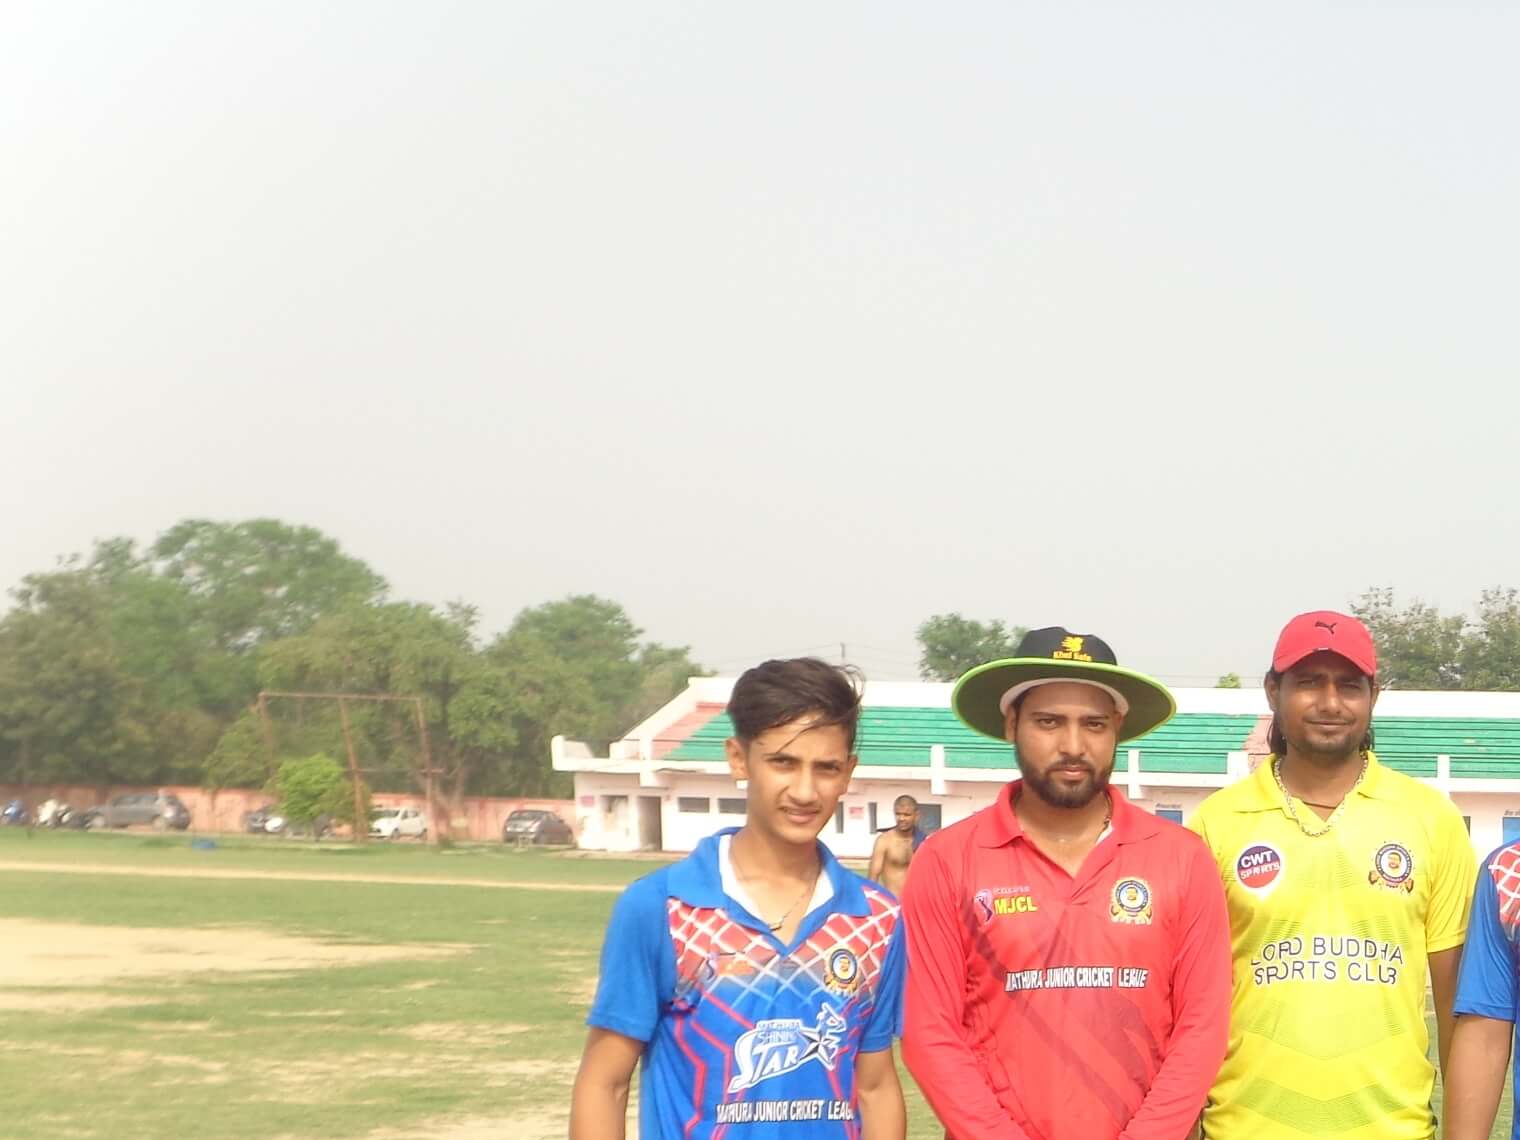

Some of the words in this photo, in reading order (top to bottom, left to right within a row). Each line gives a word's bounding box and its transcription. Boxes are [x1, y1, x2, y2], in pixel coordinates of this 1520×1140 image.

[1241, 851, 1273, 868] CWT
[994, 896, 1038, 915] MJCL
[1044, 967, 1076, 988] JUNIOR
[1076, 967, 1114, 987] CRICKET
[729, 1030, 800, 1092] STAR
[754, 1101, 789, 1121] JUNIOR
